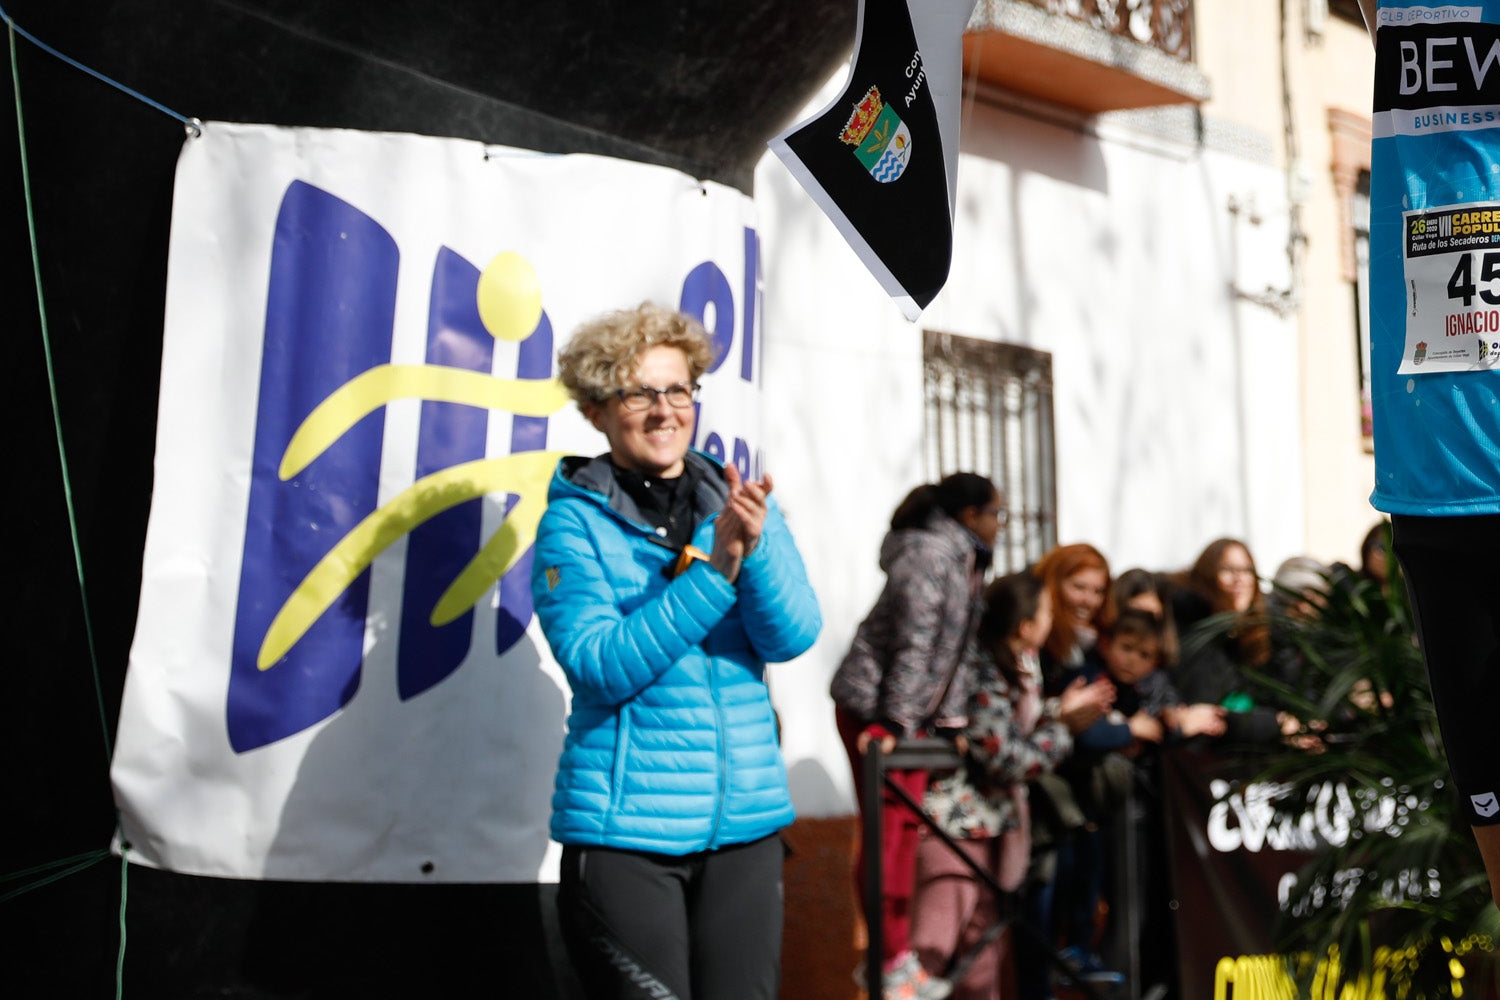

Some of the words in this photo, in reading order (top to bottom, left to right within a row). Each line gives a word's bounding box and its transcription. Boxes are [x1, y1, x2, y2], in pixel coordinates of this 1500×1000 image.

[904, 66, 925, 109] Ayun
[1411, 218, 1426, 235] 26
[1438, 214, 1452, 238] VII
[1411, 241, 1427, 252] Ruta
[1427, 240, 1437, 250] de
[1437, 238, 1448, 249] los
[1449, 234, 1490, 247] Secaderos
[1445, 310, 1500, 337] IGNACIO
